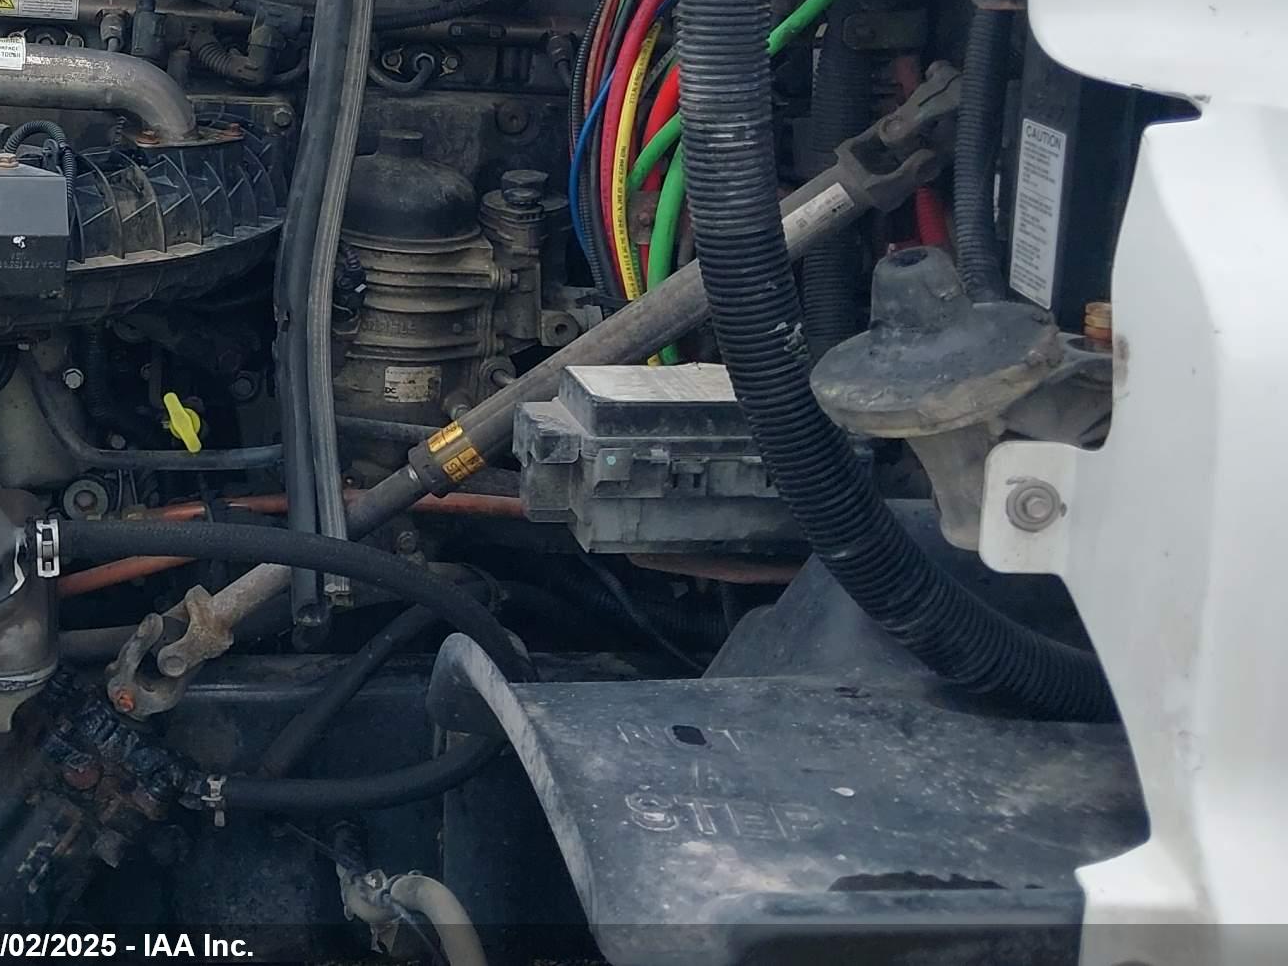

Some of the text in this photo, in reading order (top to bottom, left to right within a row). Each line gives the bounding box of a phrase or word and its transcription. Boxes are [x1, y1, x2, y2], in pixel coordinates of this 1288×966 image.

[1025, 124, 1062, 151] CAUTION
[616, 721, 748, 753] NOT
[625, 791, 825, 842] STEP
